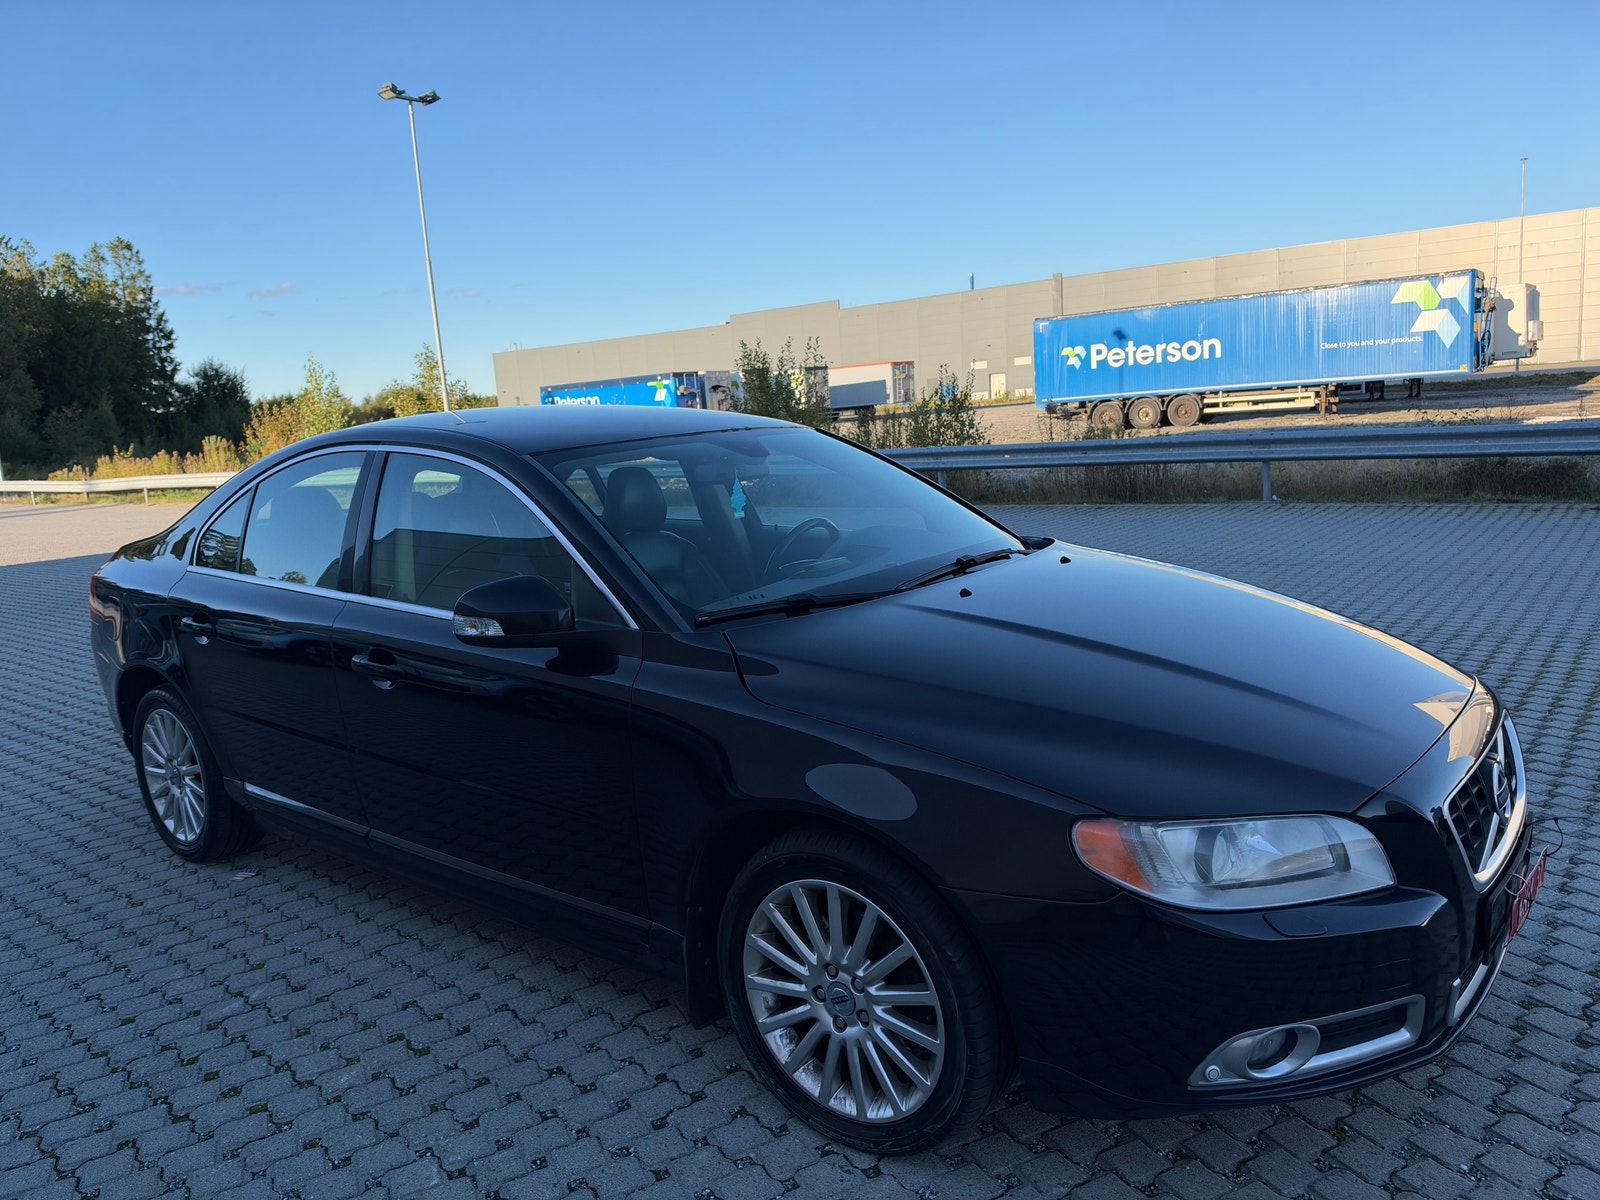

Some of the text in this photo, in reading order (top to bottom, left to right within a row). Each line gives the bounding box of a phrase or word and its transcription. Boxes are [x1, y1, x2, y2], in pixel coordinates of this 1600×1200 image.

[1347, 340, 1360, 348] you
[1361, 338, 1374, 346] and
[1391, 336, 1423, 345] products.
[1090, 338, 1222, 369] Peterson
